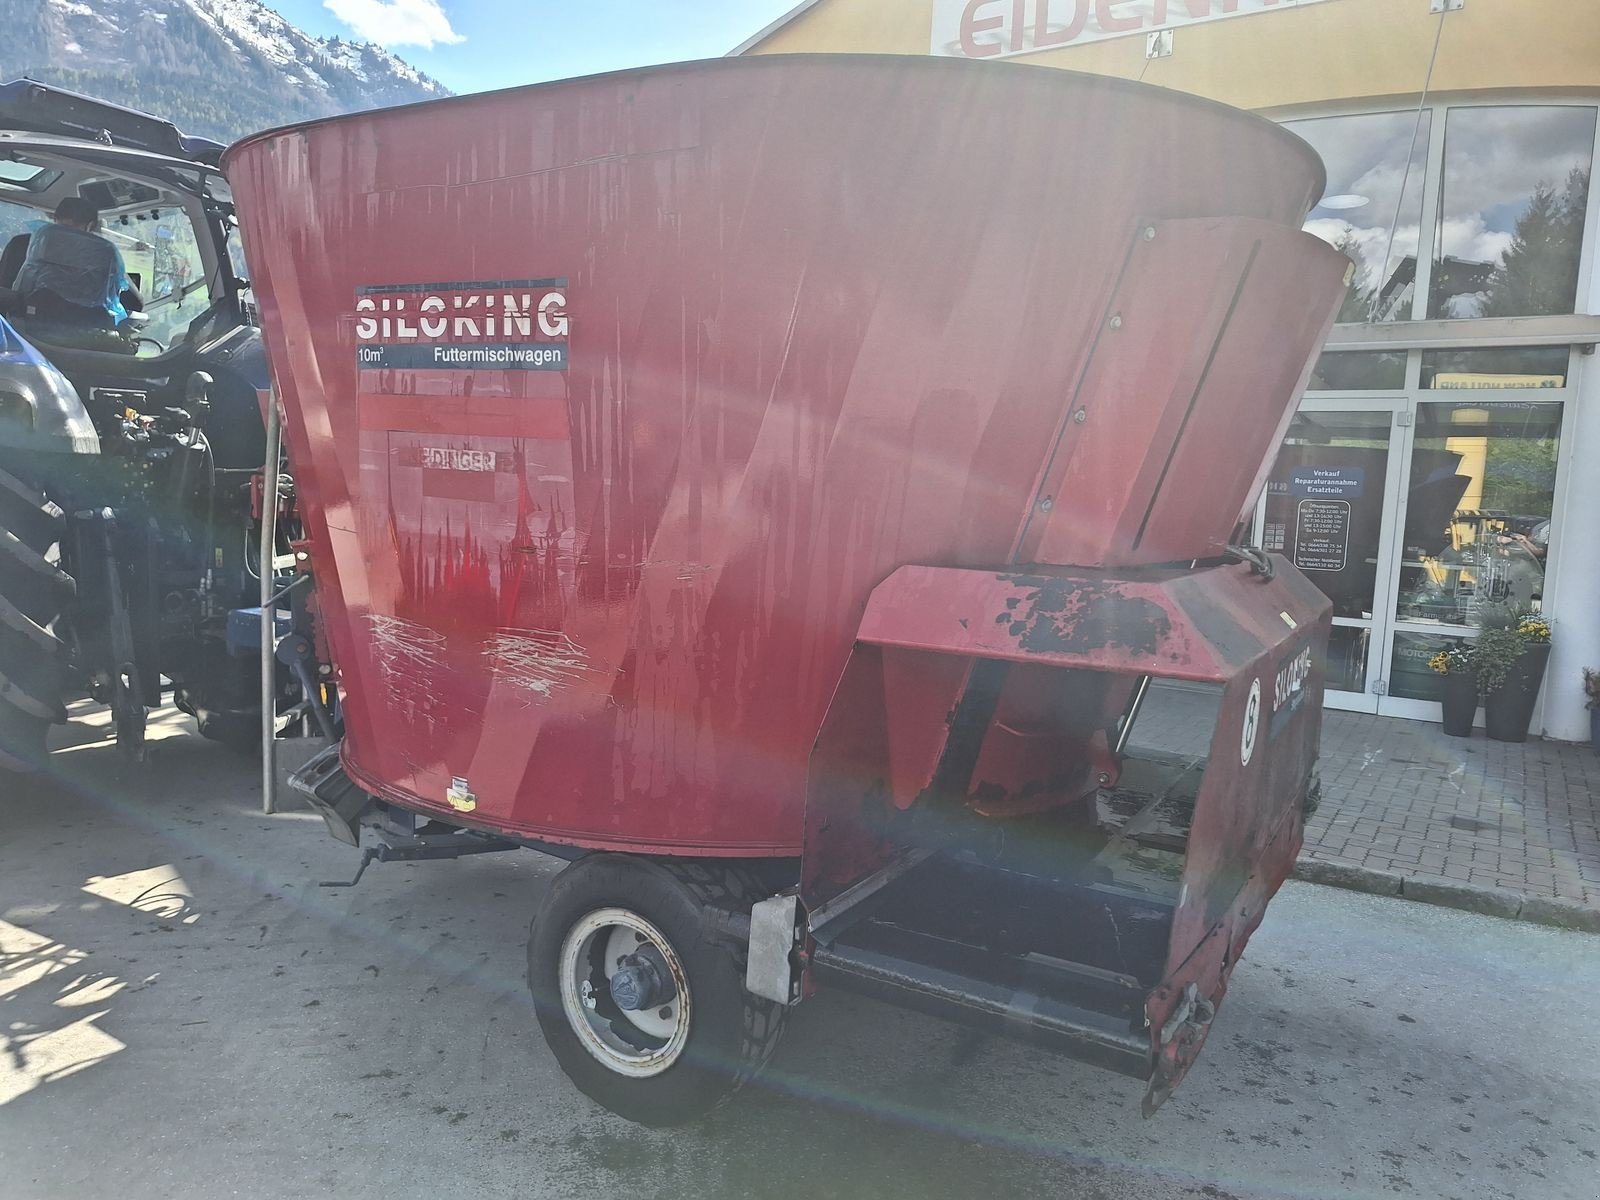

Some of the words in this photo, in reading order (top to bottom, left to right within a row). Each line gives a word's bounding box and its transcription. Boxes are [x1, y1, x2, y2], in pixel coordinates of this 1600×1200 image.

[356, 293, 568, 339] SILOKING
[434, 347, 561, 366] Futtermischwagen
[1313, 469, 1340, 477] Verkauf
[1294, 477, 1358, 486] Reparaturannahme
[1307, 486, 1343, 494] Ersatzteile
